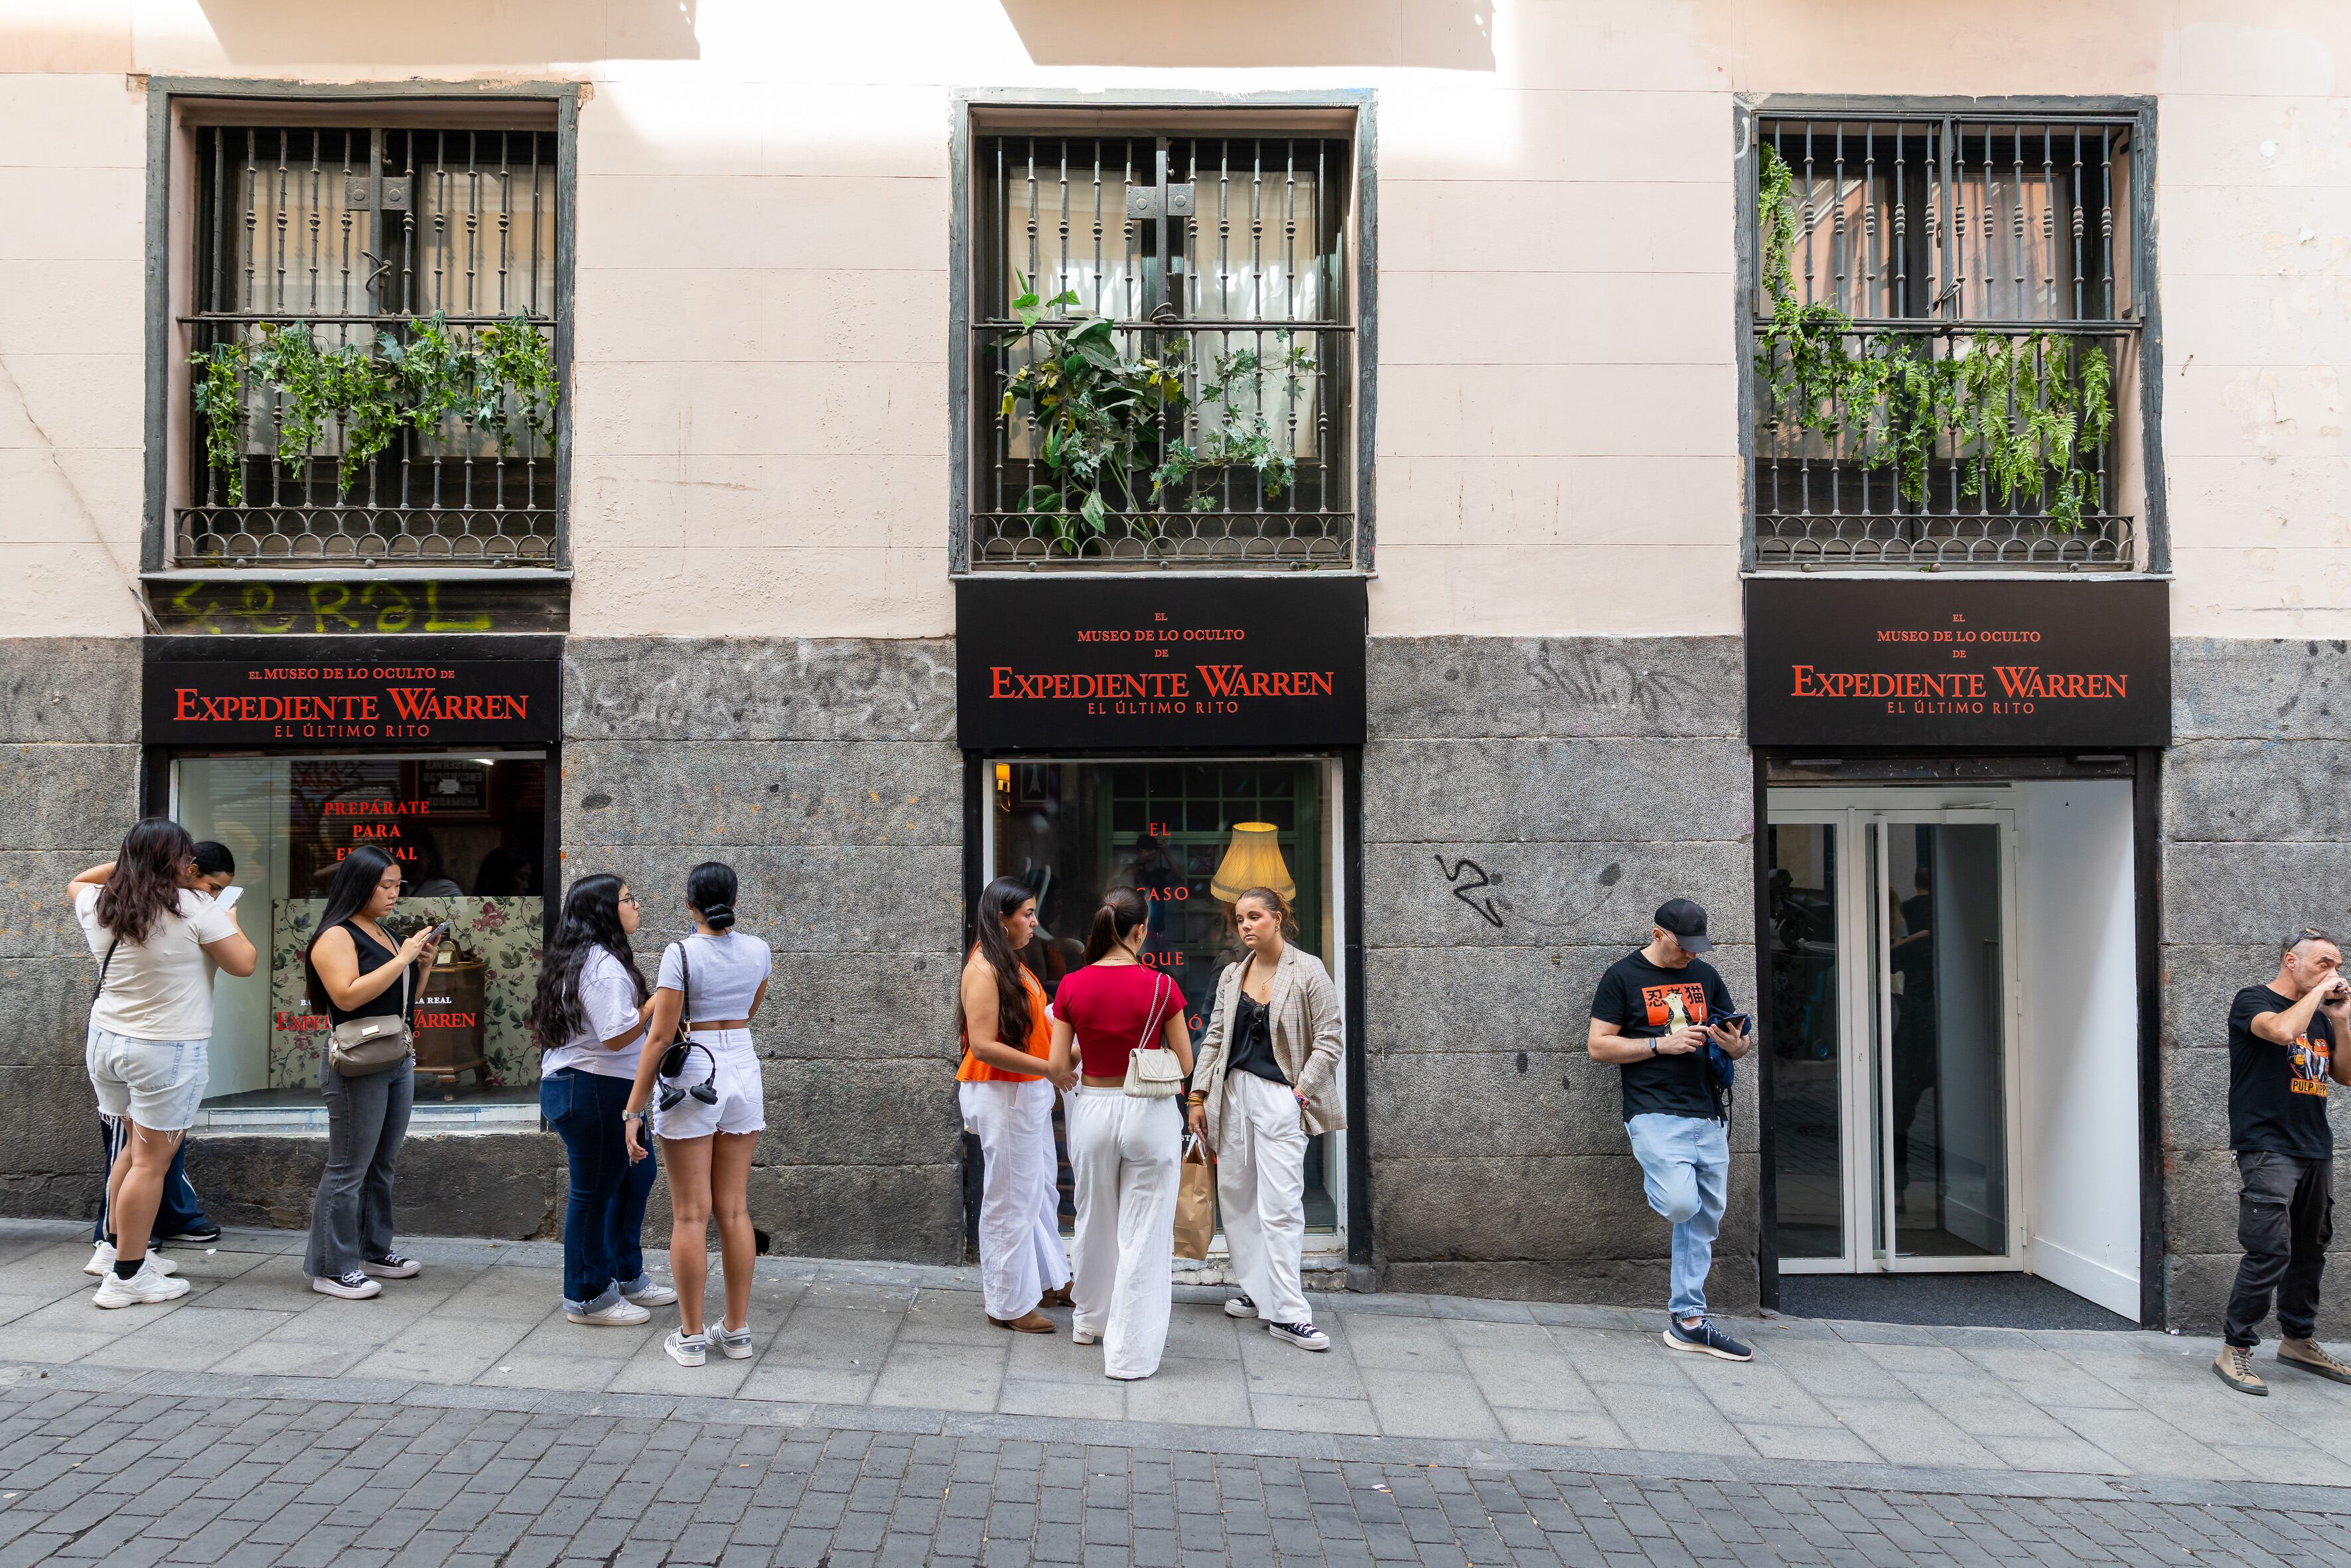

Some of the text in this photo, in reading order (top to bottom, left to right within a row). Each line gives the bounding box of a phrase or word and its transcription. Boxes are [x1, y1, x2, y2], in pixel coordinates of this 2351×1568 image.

[1155, 612, 1168, 622] EL
[1953, 614, 1965, 622] EL
[1078, 630, 1246, 642] MUSEO DE LO OCULTO
[1878, 631, 2042, 642] MUSEO DE LO OCULTO
[1155, 649, 1169, 658] DE
[1952, 650, 1966, 658] DE
[249, 668, 455, 680] EL MUSEO DE LO OCULTO DE
[989, 665, 1334, 699] EXPEDIENTE WARREN
[1791, 665, 2127, 699] EXPEDIENTE WARREN
[173, 688, 528, 721] EXPEDIENTE WARREN
[1088, 700, 1239, 715] EL ÚLTIMO RITO
[1888, 699, 2034, 714] EL ÚLTIMO RITO
[275, 723, 430, 737] EL ÚLTIMO RITO
[324, 798, 430, 816] PREPÁRATE
[352, 824, 401, 839] PARA
[1150, 821, 1171, 837] EL
[1141, 952, 1184, 969] QUE
[2293, 1080, 2314, 1092] PULP
